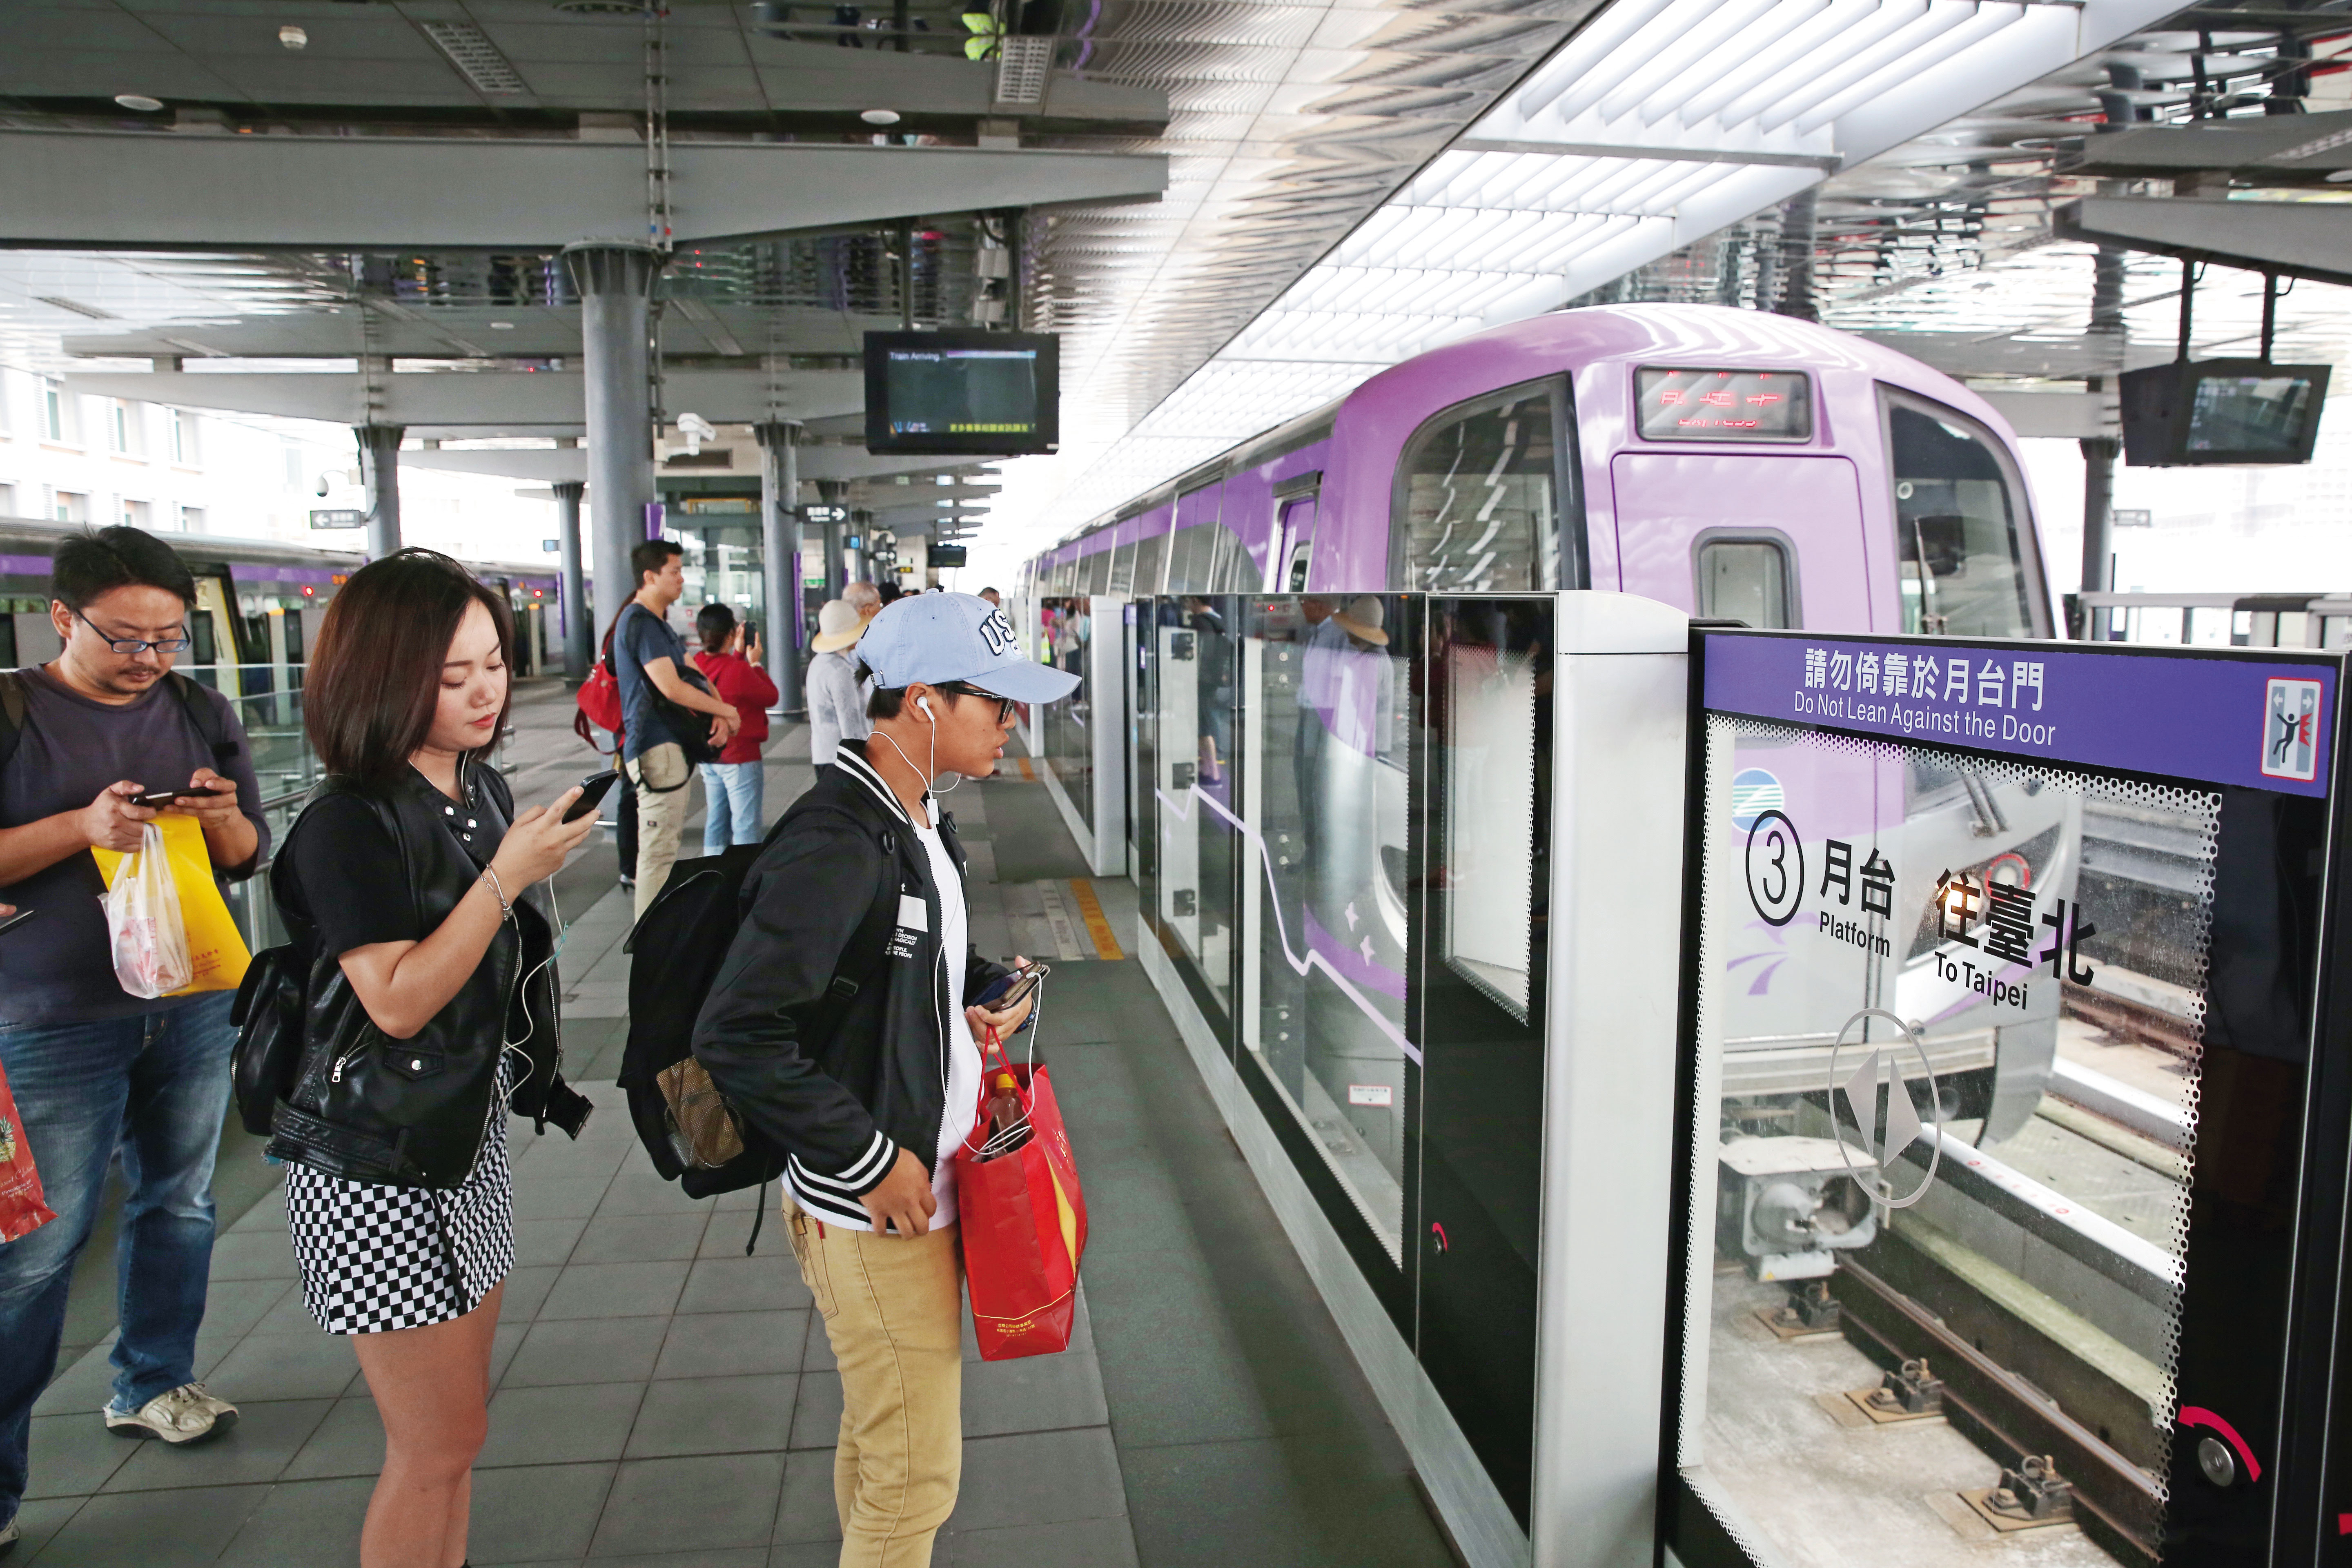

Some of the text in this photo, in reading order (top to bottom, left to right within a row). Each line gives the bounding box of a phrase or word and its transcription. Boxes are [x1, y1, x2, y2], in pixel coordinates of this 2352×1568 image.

[1805, 648, 2044, 711] 請勿倚靠於月台門
[1795, 690, 2056, 746] Do Not Lean Against the Door
[1820, 838, 1896, 921] 月台
[898, 932, 918, 941] DECISION
[1820, 911, 1890, 958] Platform
[1935, 868, 2096, 987] 往臺北
[1934, 951, 2028, 1011] To Taipei
